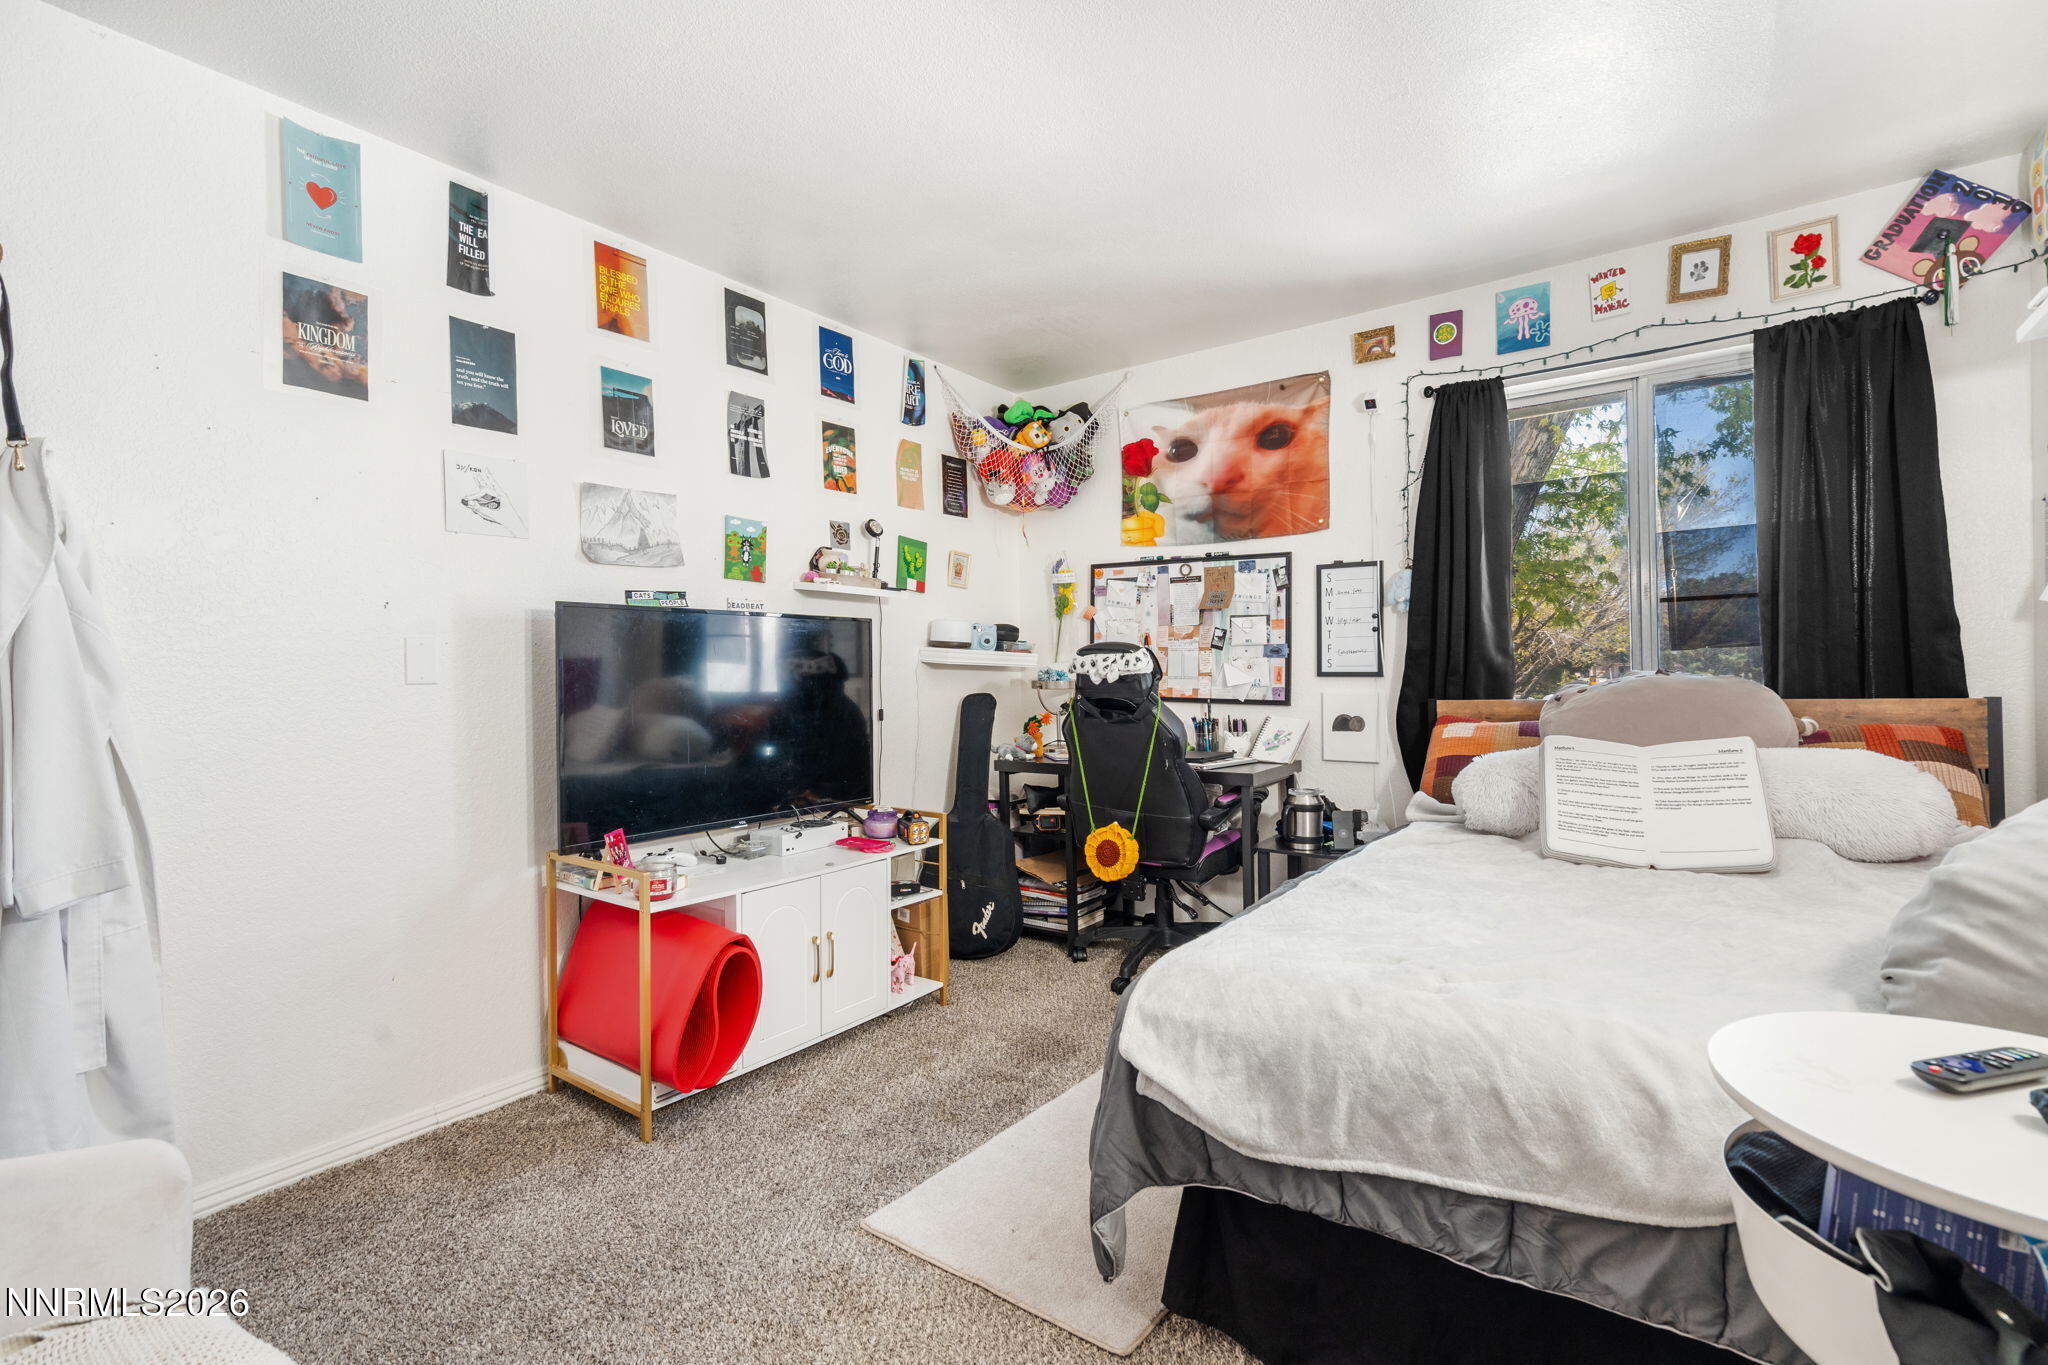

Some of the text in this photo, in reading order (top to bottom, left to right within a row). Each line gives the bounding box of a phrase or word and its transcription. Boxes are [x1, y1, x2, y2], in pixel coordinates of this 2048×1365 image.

[1863, 171, 1950, 262] GRADUATION
[459, 221, 474, 236] THE
[458, 232, 479, 248] WILL
[458, 243, 486, 261] FILLED
[599, 264, 639, 286] BLESSED
[599, 275, 627, 290] IS THE
[1590, 266, 1626, 284] WANTED
[599, 283, 641, 304] ONE WHO
[599, 292, 641, 312] ENDURES
[599, 301, 631, 317] TRIALS
[297, 321, 356, 352] KINGDOM
[822, 352, 853, 375] GOD
[1326, 573, 1332, 583] S
[1325, 587, 1333, 597] M
[1327, 601, 1332, 611] T
[1325, 616, 1334, 626] W
[1327, 630, 1332, 640] T
[1327, 643, 1332, 653] F
[1327, 658, 1333, 669] S
[972, 901, 995, 940] Fender
